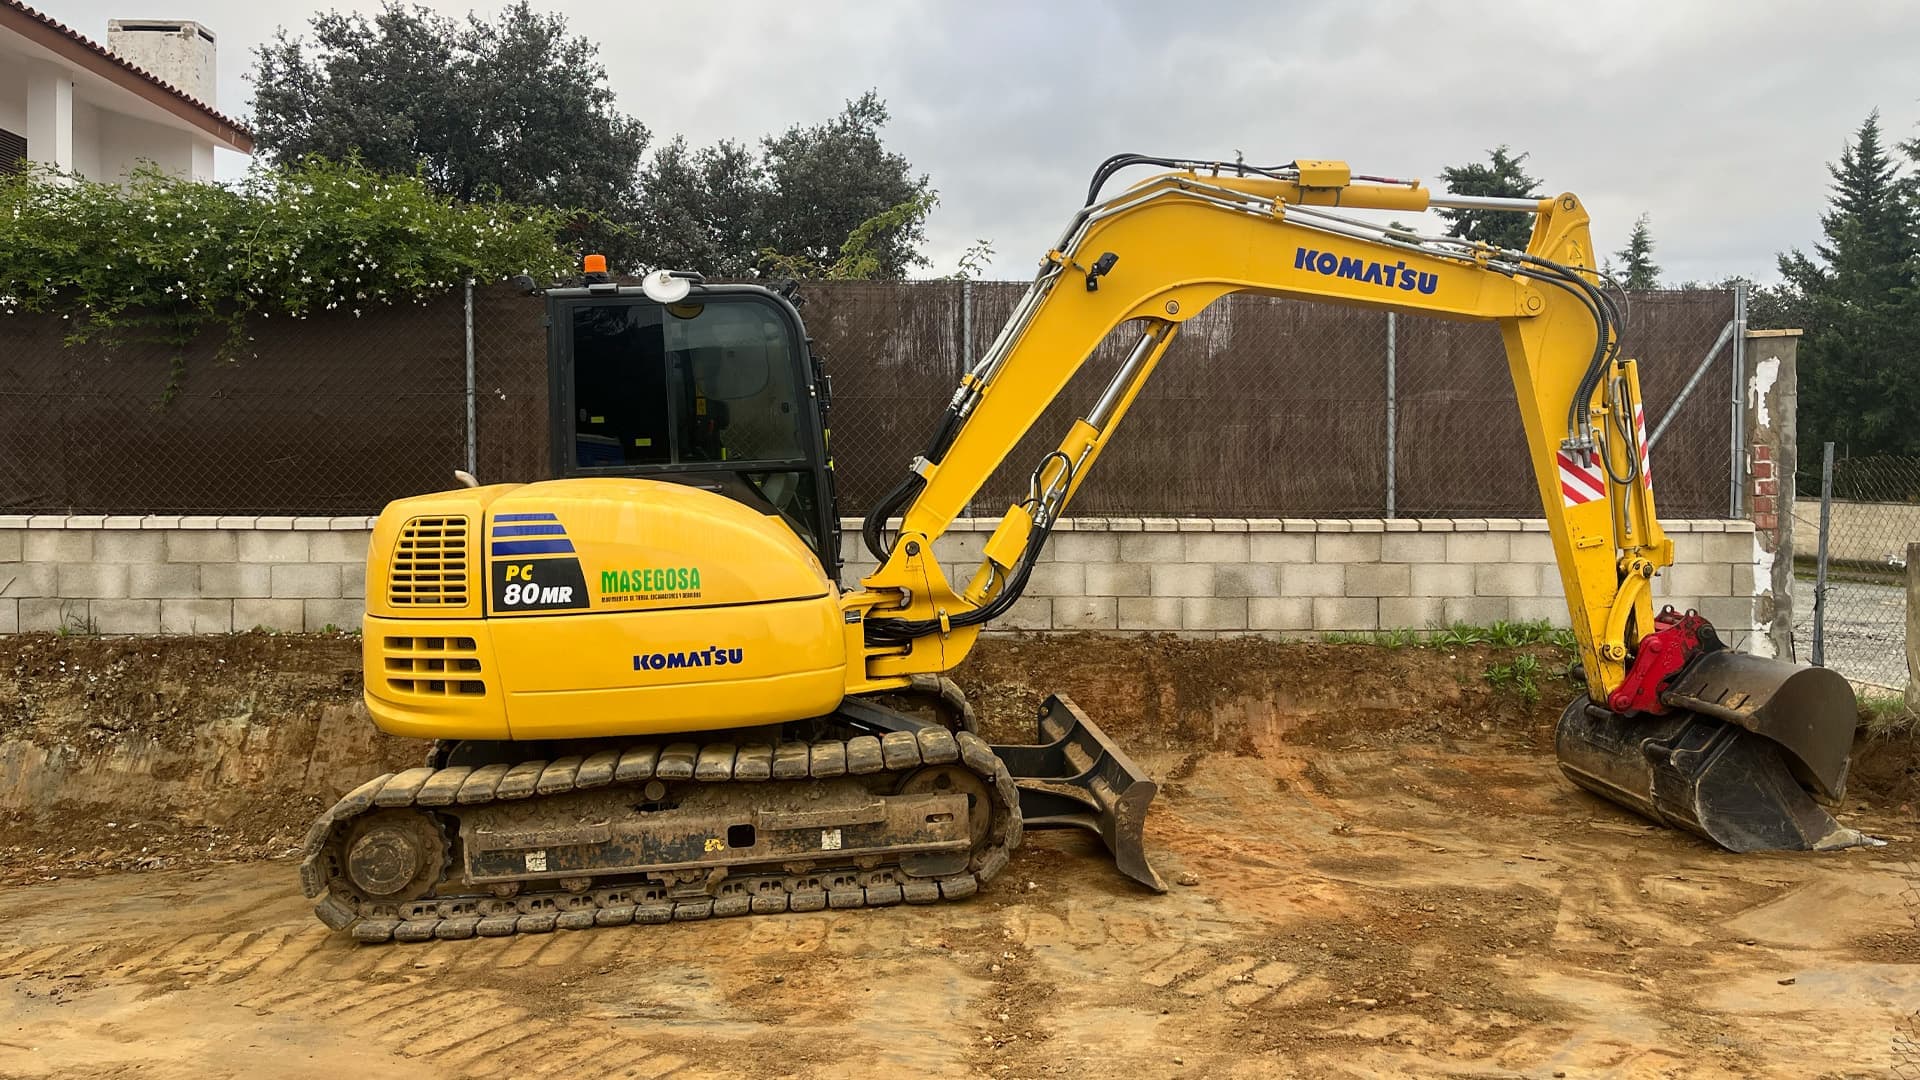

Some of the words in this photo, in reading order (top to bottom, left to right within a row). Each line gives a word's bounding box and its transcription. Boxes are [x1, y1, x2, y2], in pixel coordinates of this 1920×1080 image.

[1294, 247, 1438, 295] KOMATSU
[505, 564, 534, 582] PC
[601, 567, 700, 593] MASEGOSA
[633, 646, 743, 671] KOMATSU
